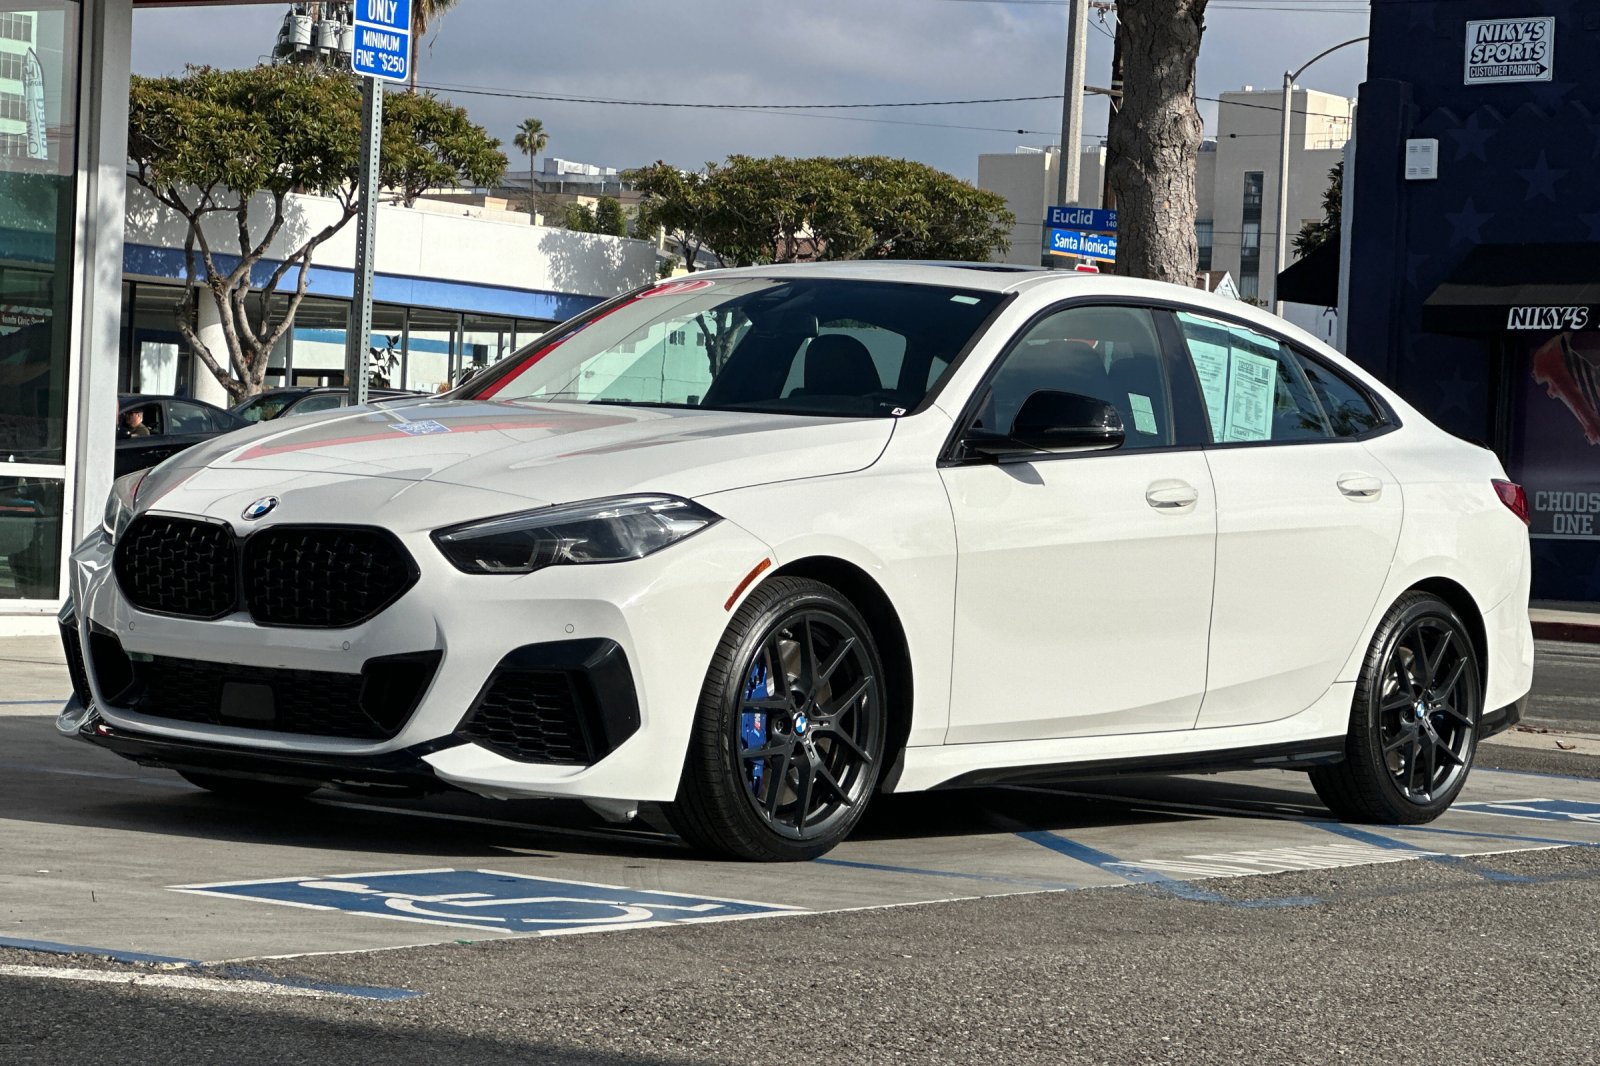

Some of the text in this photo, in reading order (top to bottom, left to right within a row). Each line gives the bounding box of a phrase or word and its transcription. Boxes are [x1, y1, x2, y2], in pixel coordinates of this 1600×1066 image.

[368, 0, 397, 24] ONLY
[363, 30, 399, 52] MINIMUM
[1476, 22, 1545, 44] NIKY'S
[356, 49, 404, 73] FINE $250
[1470, 42, 1546, 64] SPORTS
[1470, 64, 1540, 77] CUSTOMER PARKING
[1052, 209, 1094, 225] Euclid
[1054, 233, 1077, 250] Santa
[1080, 237, 1108, 255] Monica
[1507, 306, 1590, 330] NIKY'S
[1553, 513, 1594, 535] ONE
